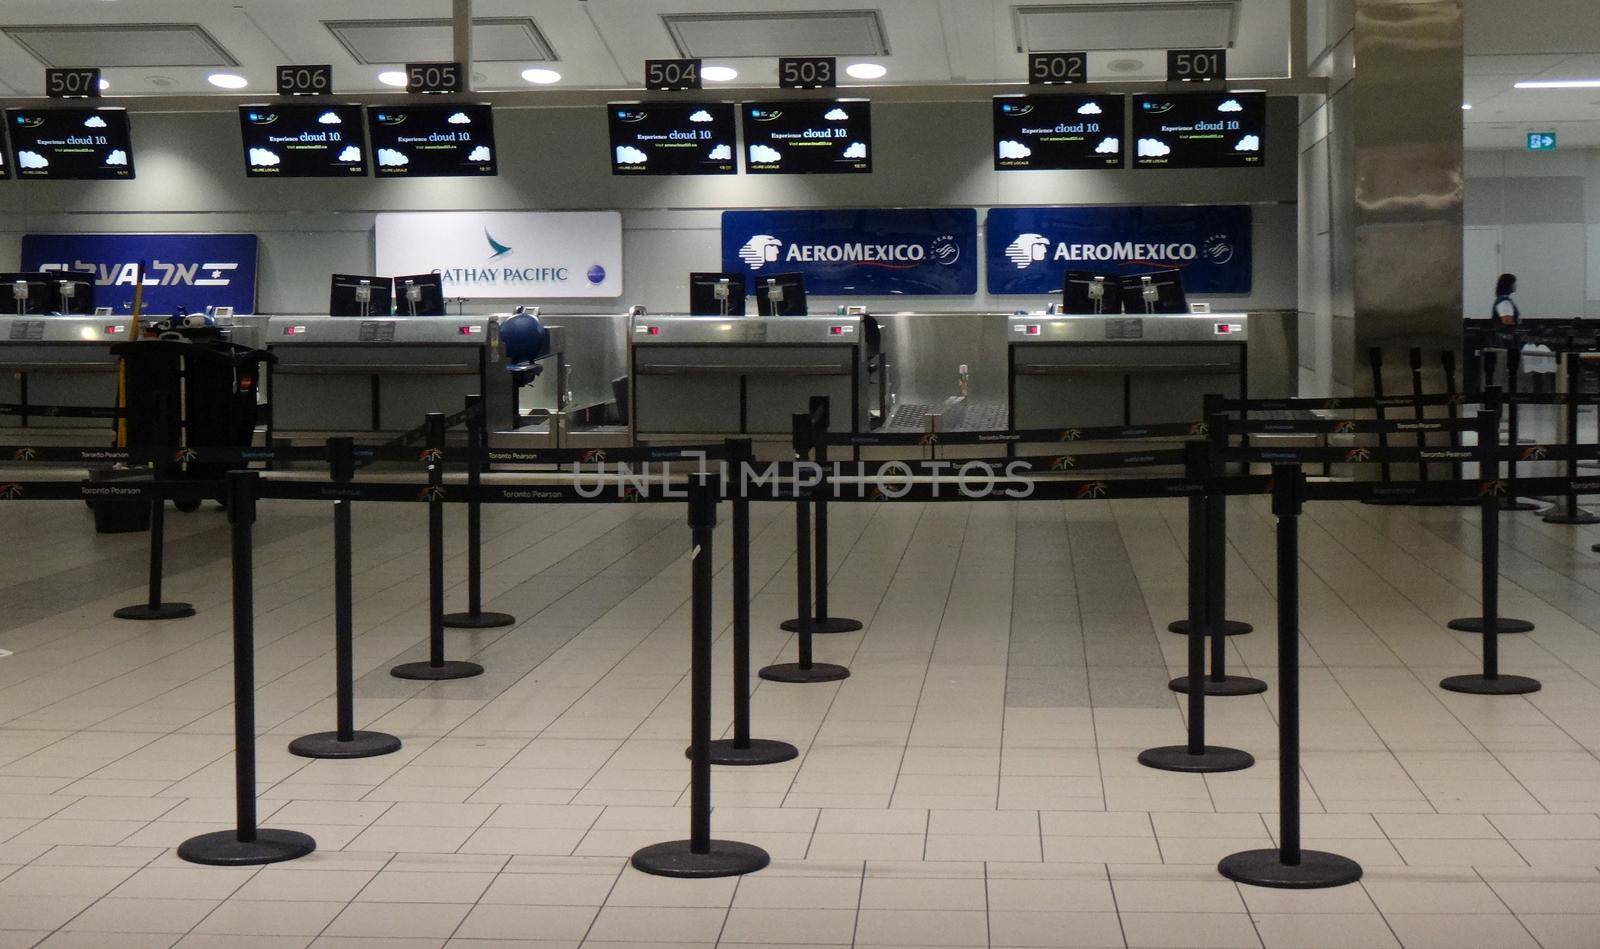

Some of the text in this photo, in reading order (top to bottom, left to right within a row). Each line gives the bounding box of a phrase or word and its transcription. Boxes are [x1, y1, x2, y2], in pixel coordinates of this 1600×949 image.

[1034, 57, 1082, 78] 502
[1176, 54, 1218, 75] 501
[411, 67, 456, 87] 505
[649, 63, 697, 84] 504
[785, 61, 831, 82] 503
[51, 72, 93, 92] 507
[280, 69, 327, 89] 506
[1055, 123, 1084, 133] cloud
[1194, 120, 1224, 131] cloud
[300, 132, 326, 142] cloud
[429, 132, 455, 142] cloud
[669, 129, 696, 140] cloud
[803, 128, 831, 138] cloud
[67, 135, 93, 145] cloud
[503, 267, 568, 282] PACIFIC
[81, 487, 141, 495] Toronto Pearson
[503, 490, 562, 498] Toronto Pearson
